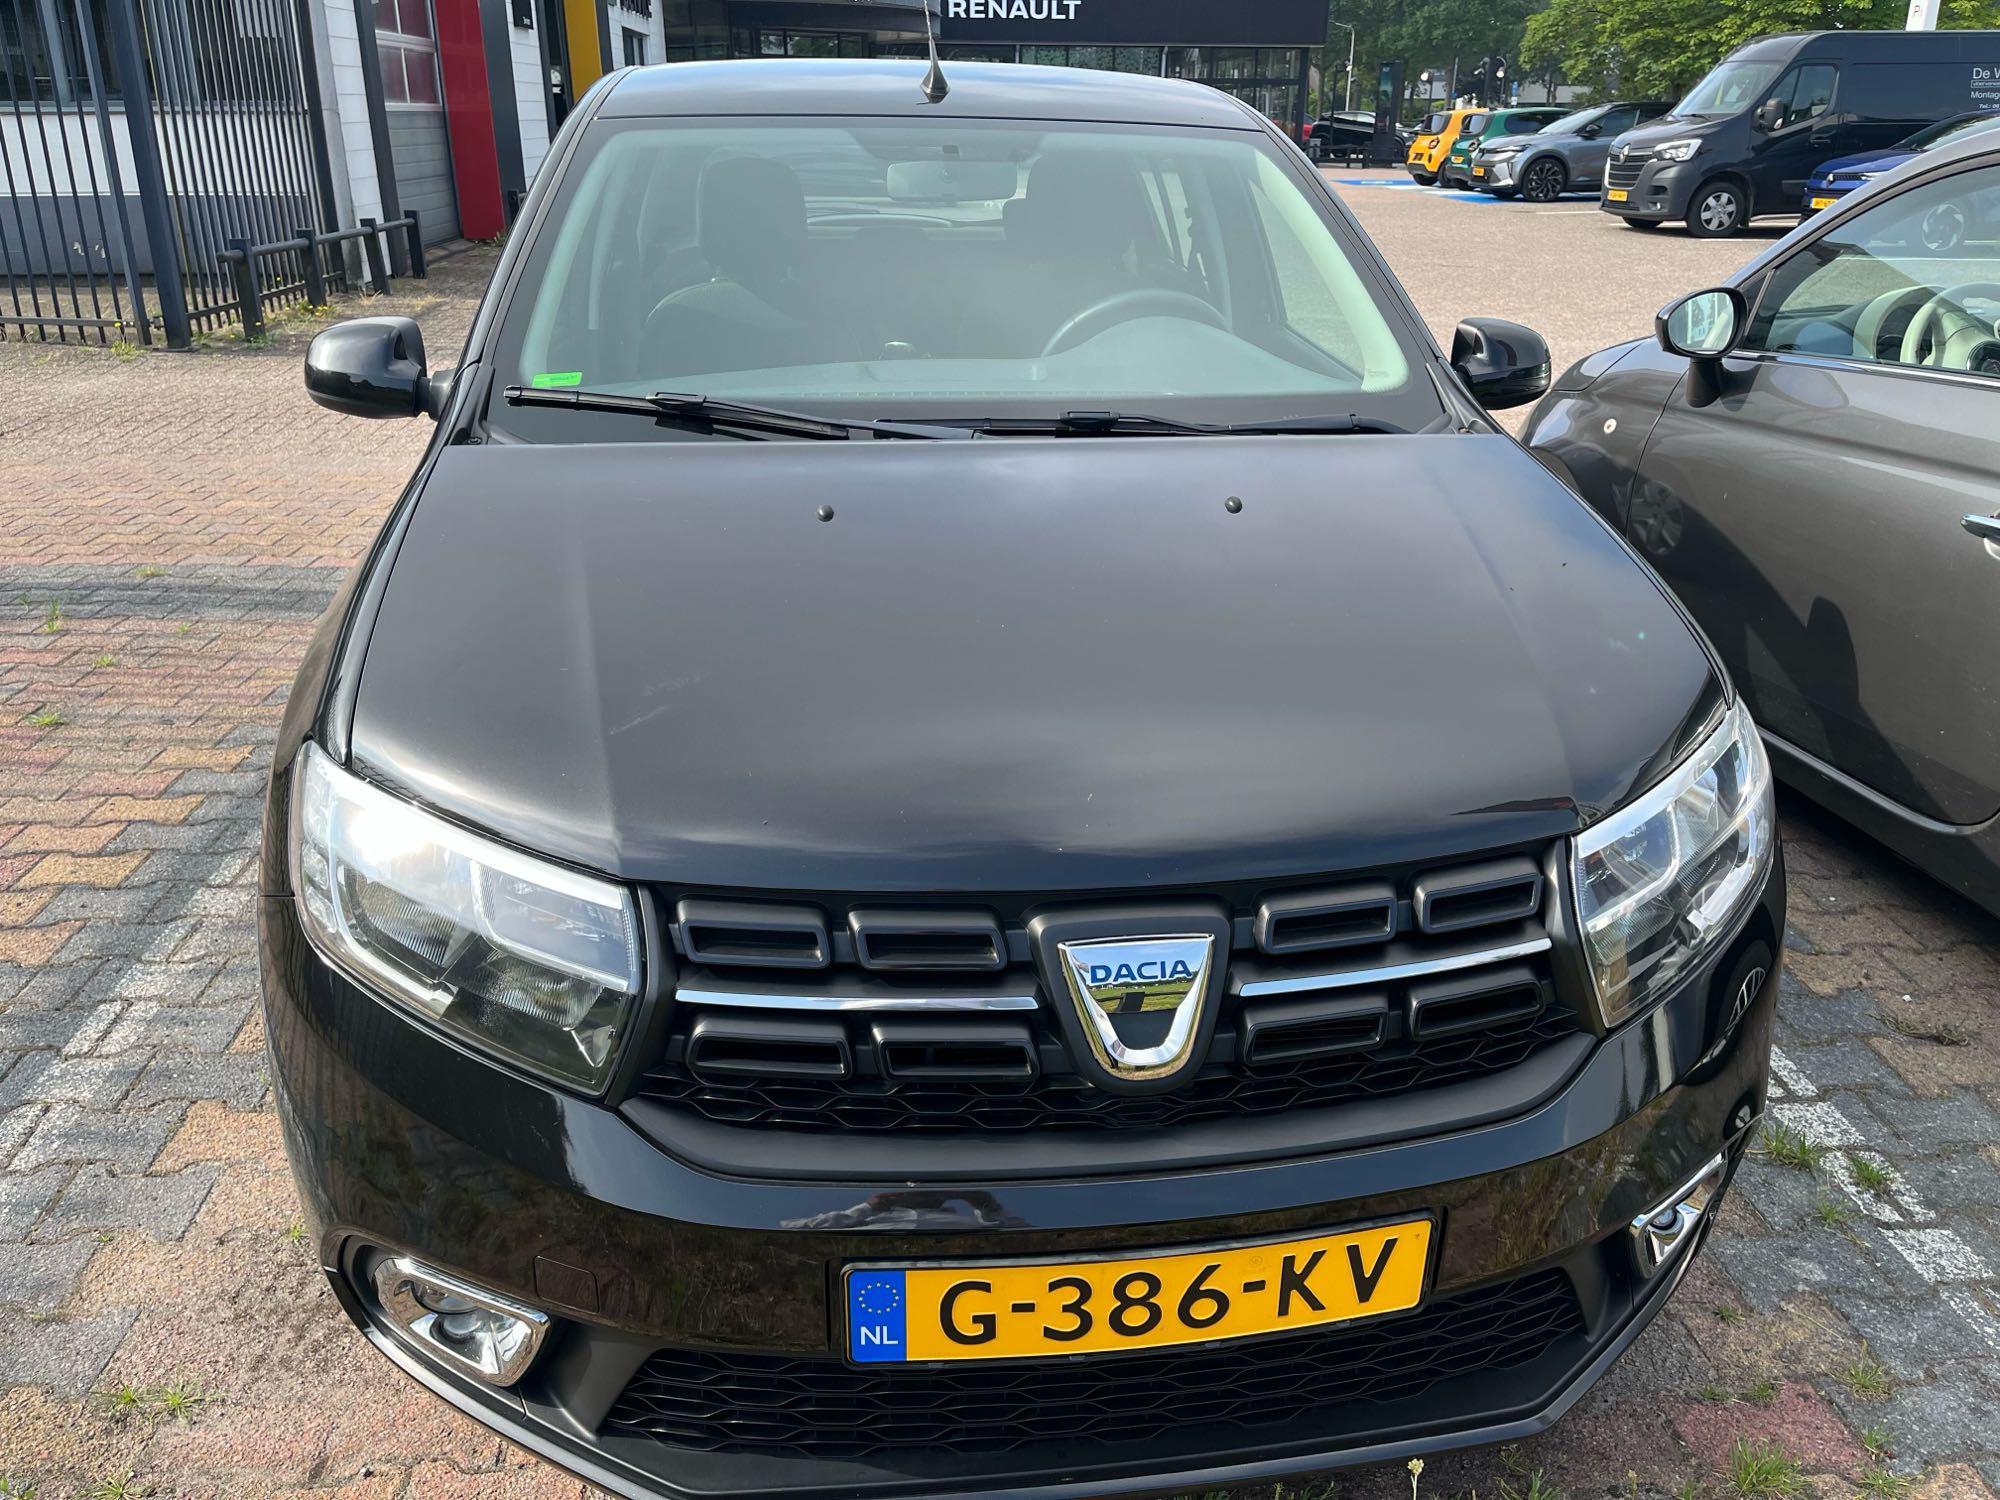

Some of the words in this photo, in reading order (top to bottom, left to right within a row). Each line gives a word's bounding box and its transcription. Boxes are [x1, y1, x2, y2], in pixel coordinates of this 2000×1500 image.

[948, 0, 1082, 20] RENAULT
[1973, 67, 1991, 79] De
[1970, 91, 2000, 100] Montag
[1090, 959, 1193, 984] DACIA
[938, 1237, 1400, 1346] G-386-KV
[860, 1325, 899, 1346] NL
